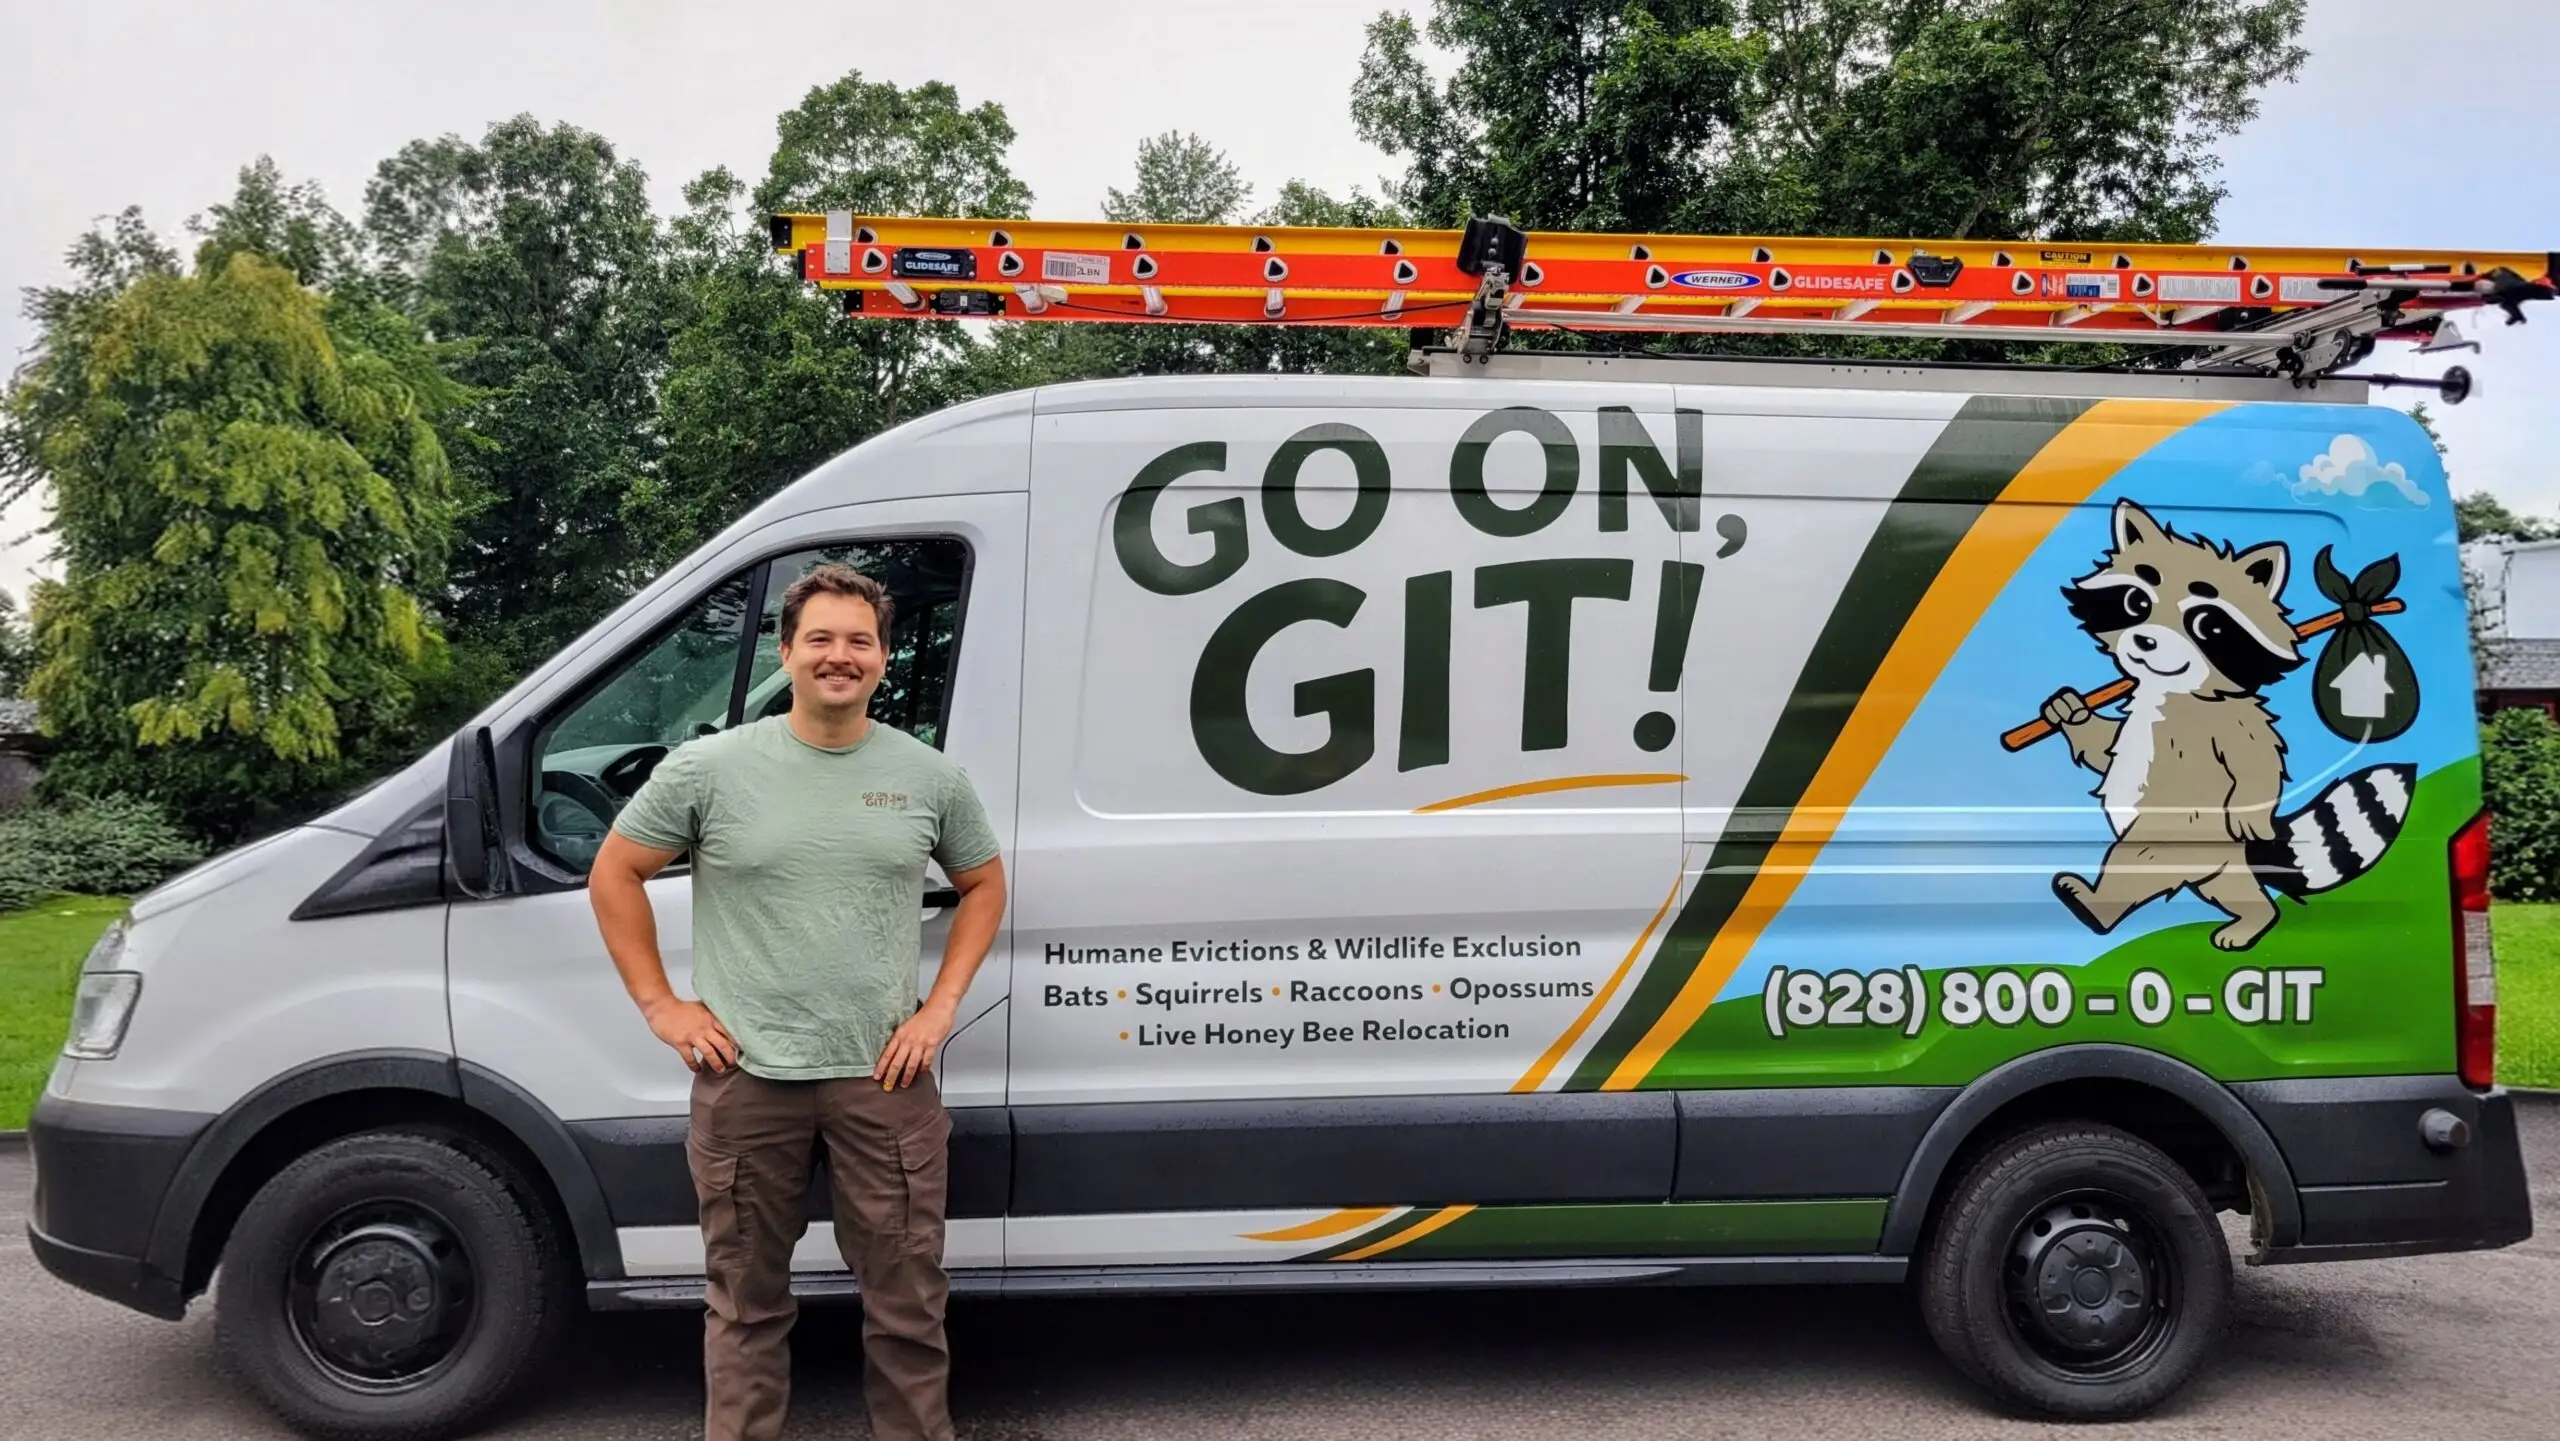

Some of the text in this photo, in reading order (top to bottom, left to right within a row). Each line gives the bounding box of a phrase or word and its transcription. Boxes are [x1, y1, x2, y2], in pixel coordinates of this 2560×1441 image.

[905, 261, 960, 272] GLIDESAFE
[2044, 252, 2087, 260] CAUTION
[1691, 275, 1743, 285] WERNER
[1794, 275, 1885, 291] GLIDESAFE
[1113, 405, 1748, 596] GO ON,
[1190, 557, 1704, 796] GIT!
[1045, 935, 1581, 965] Humane Evictions & Wildlife Exclusion
[1044, 977, 1594, 1011] Bats Squirrels Raccoons Opossums
[1764, 968, 1927, 1036] (828)
[1940, 970, 2073, 1025] 800
[2129, 970, 2172, 1025] 0
[2223, 969, 2323, 1023] GIT
[1139, 1018, 1509, 1050] Live Honey Bee Relocation
